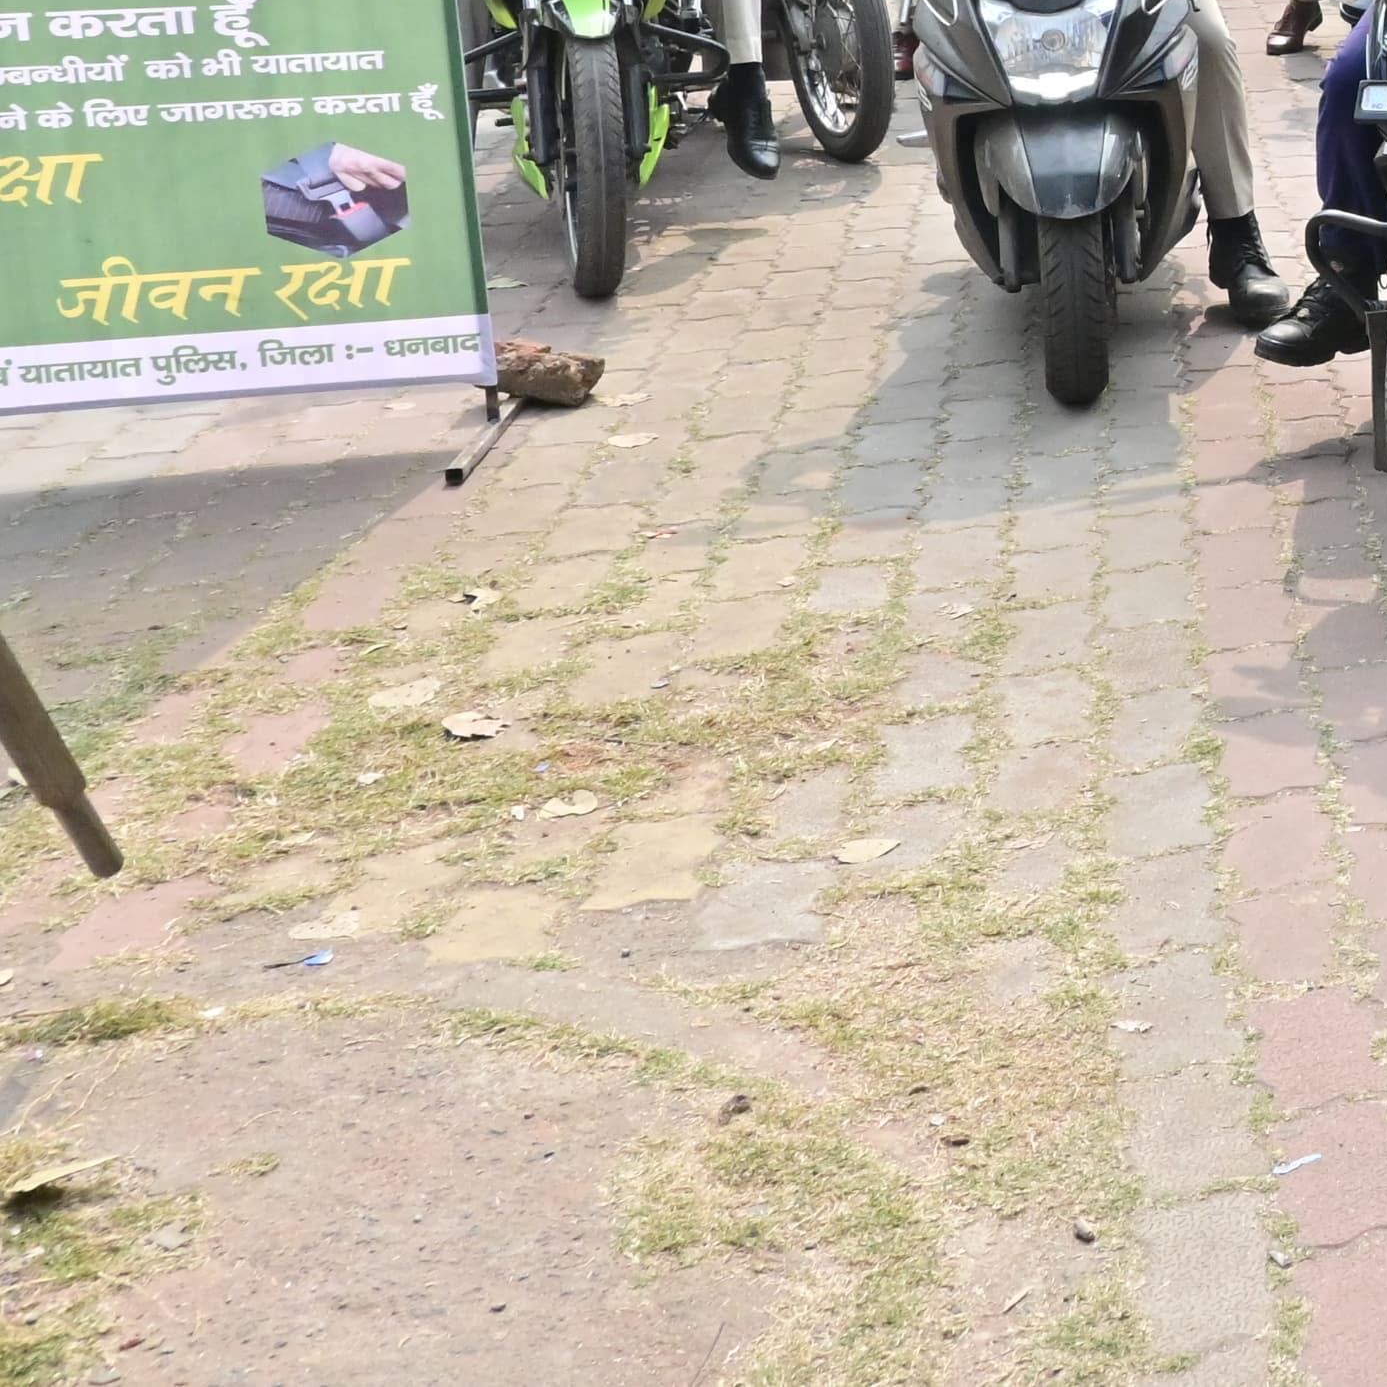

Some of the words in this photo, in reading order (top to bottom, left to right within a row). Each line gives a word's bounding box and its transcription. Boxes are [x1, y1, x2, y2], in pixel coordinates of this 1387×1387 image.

[45, 6, 197, 40] करता
[144, 52, 192, 79] को
[202, 48, 242, 78] भी
[251, 50, 384, 76] यातायात
[35, 101, 74, 129] के
[82, 98, 150, 128] लिए
[157, 96, 304, 124] जागरूक
[312, 92, 401, 117] करता
[408, 82, 444, 121] हूँ
[56, 256, 262, 326] जीवन
[274, 257, 411, 321] रक्षा
[18, 357, 143, 385] यातायात
[150, 344, 248, 386] पुलिस,
[258, 338, 335, 369] जिला
[383, 331, 481, 361] धनबाद
